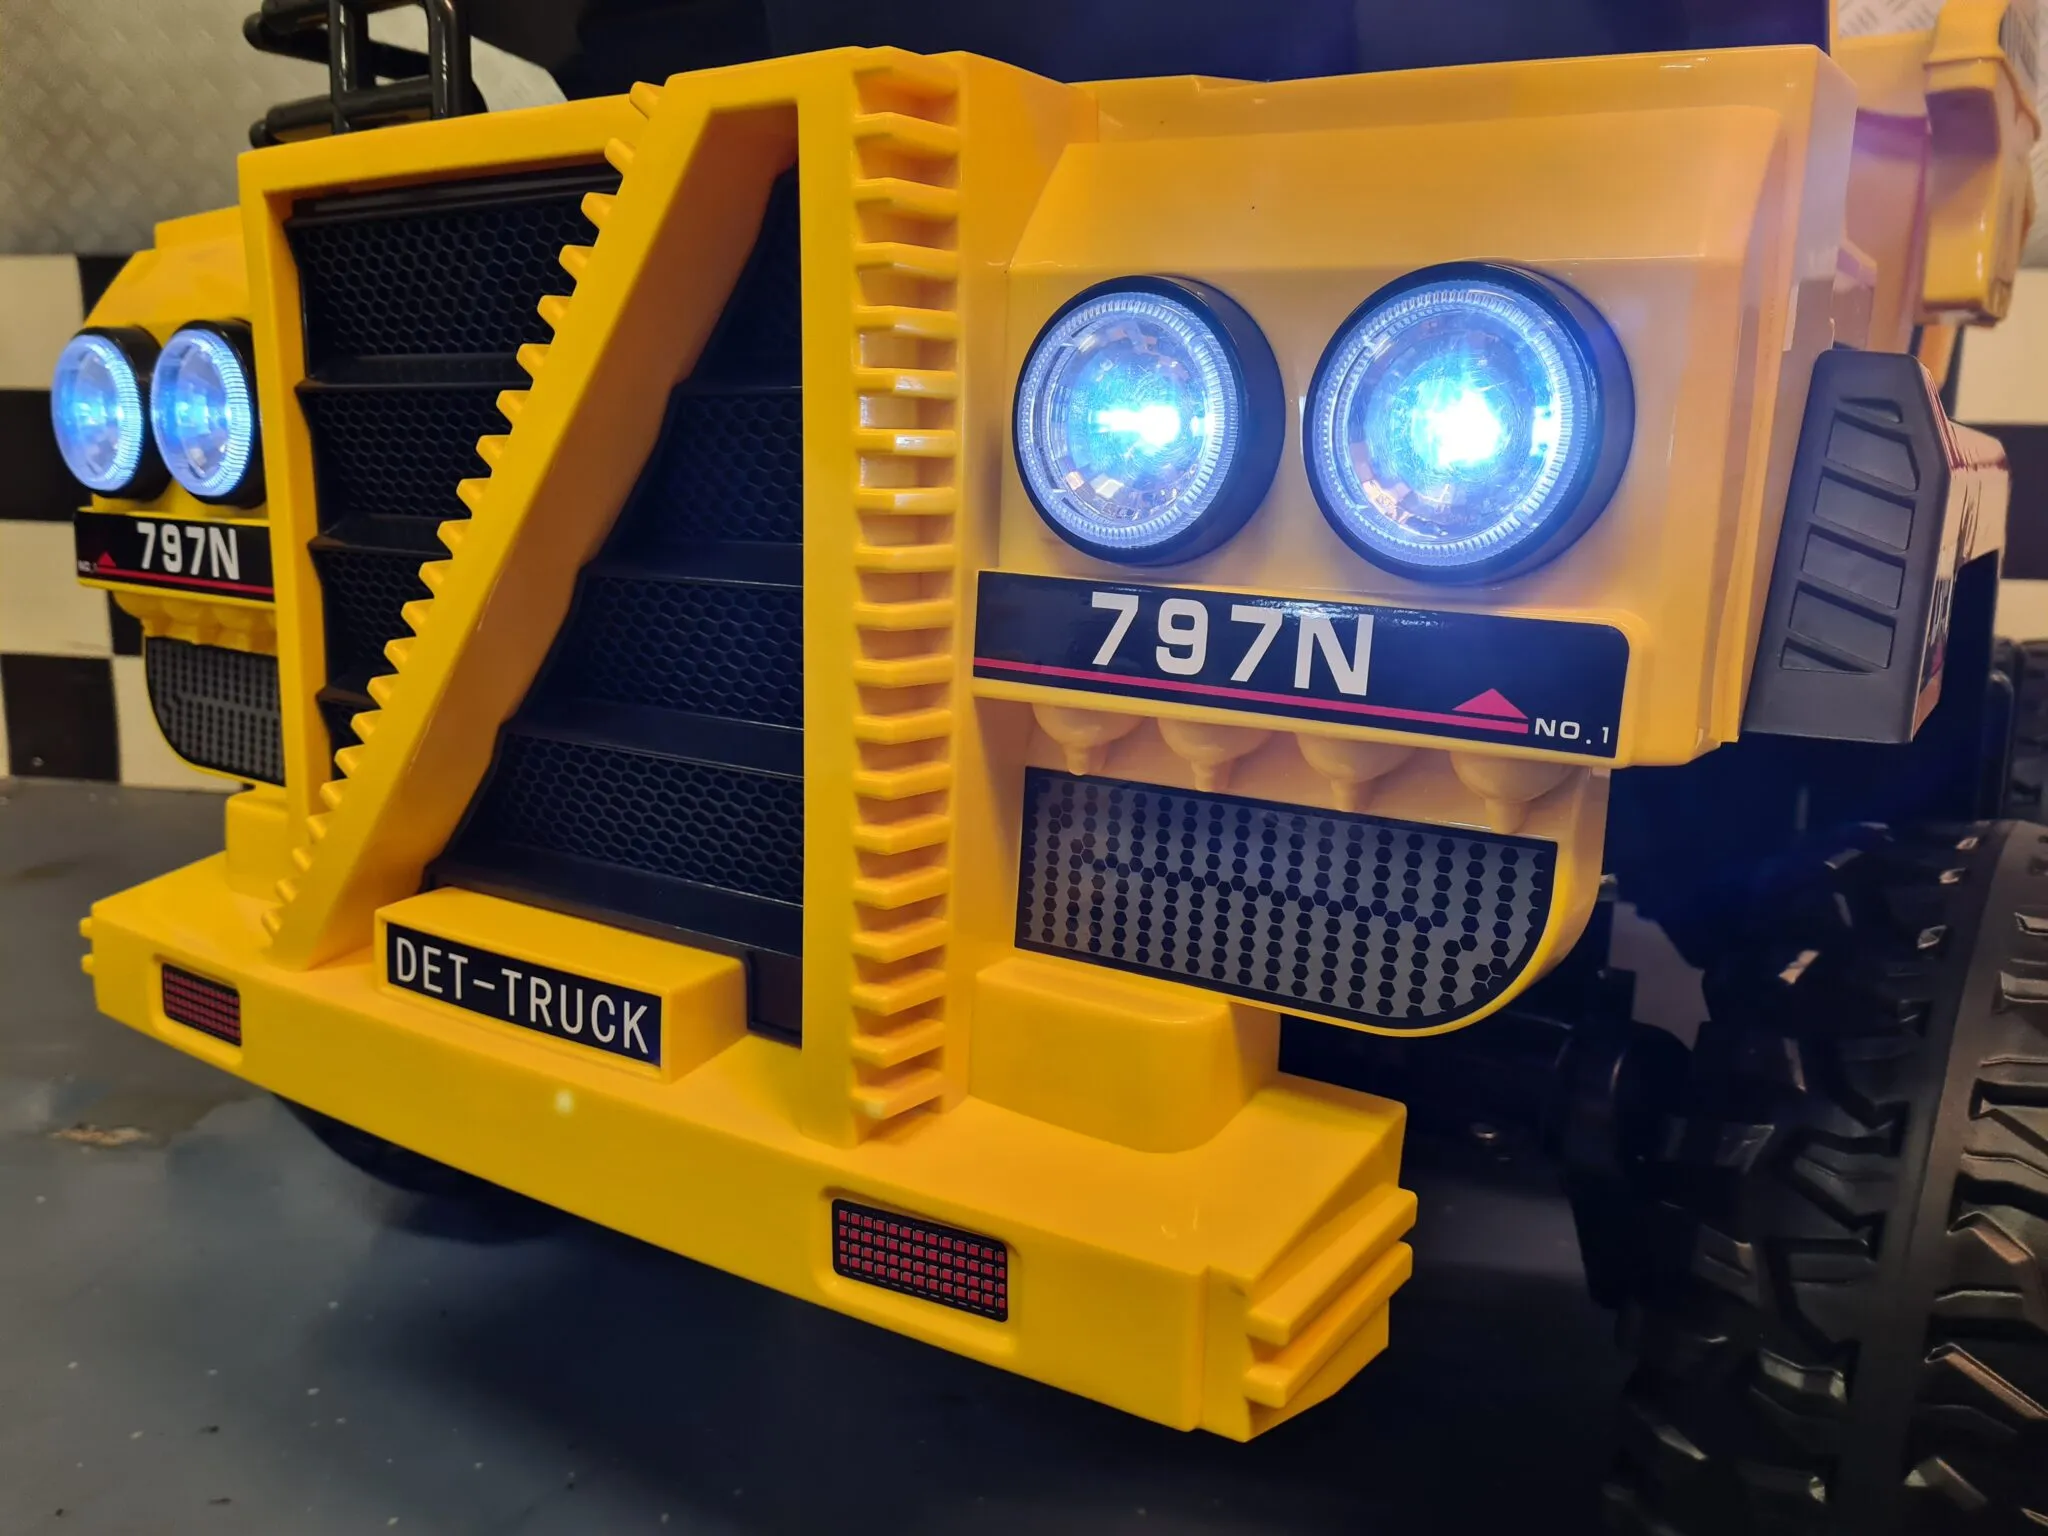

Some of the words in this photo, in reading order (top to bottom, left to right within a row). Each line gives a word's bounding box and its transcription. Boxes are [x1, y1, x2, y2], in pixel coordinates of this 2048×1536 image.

[136, 521, 240, 580] 797N
[1091, 591, 1374, 697] 797N
[396, 936, 649, 1054] DET-TRUCK
